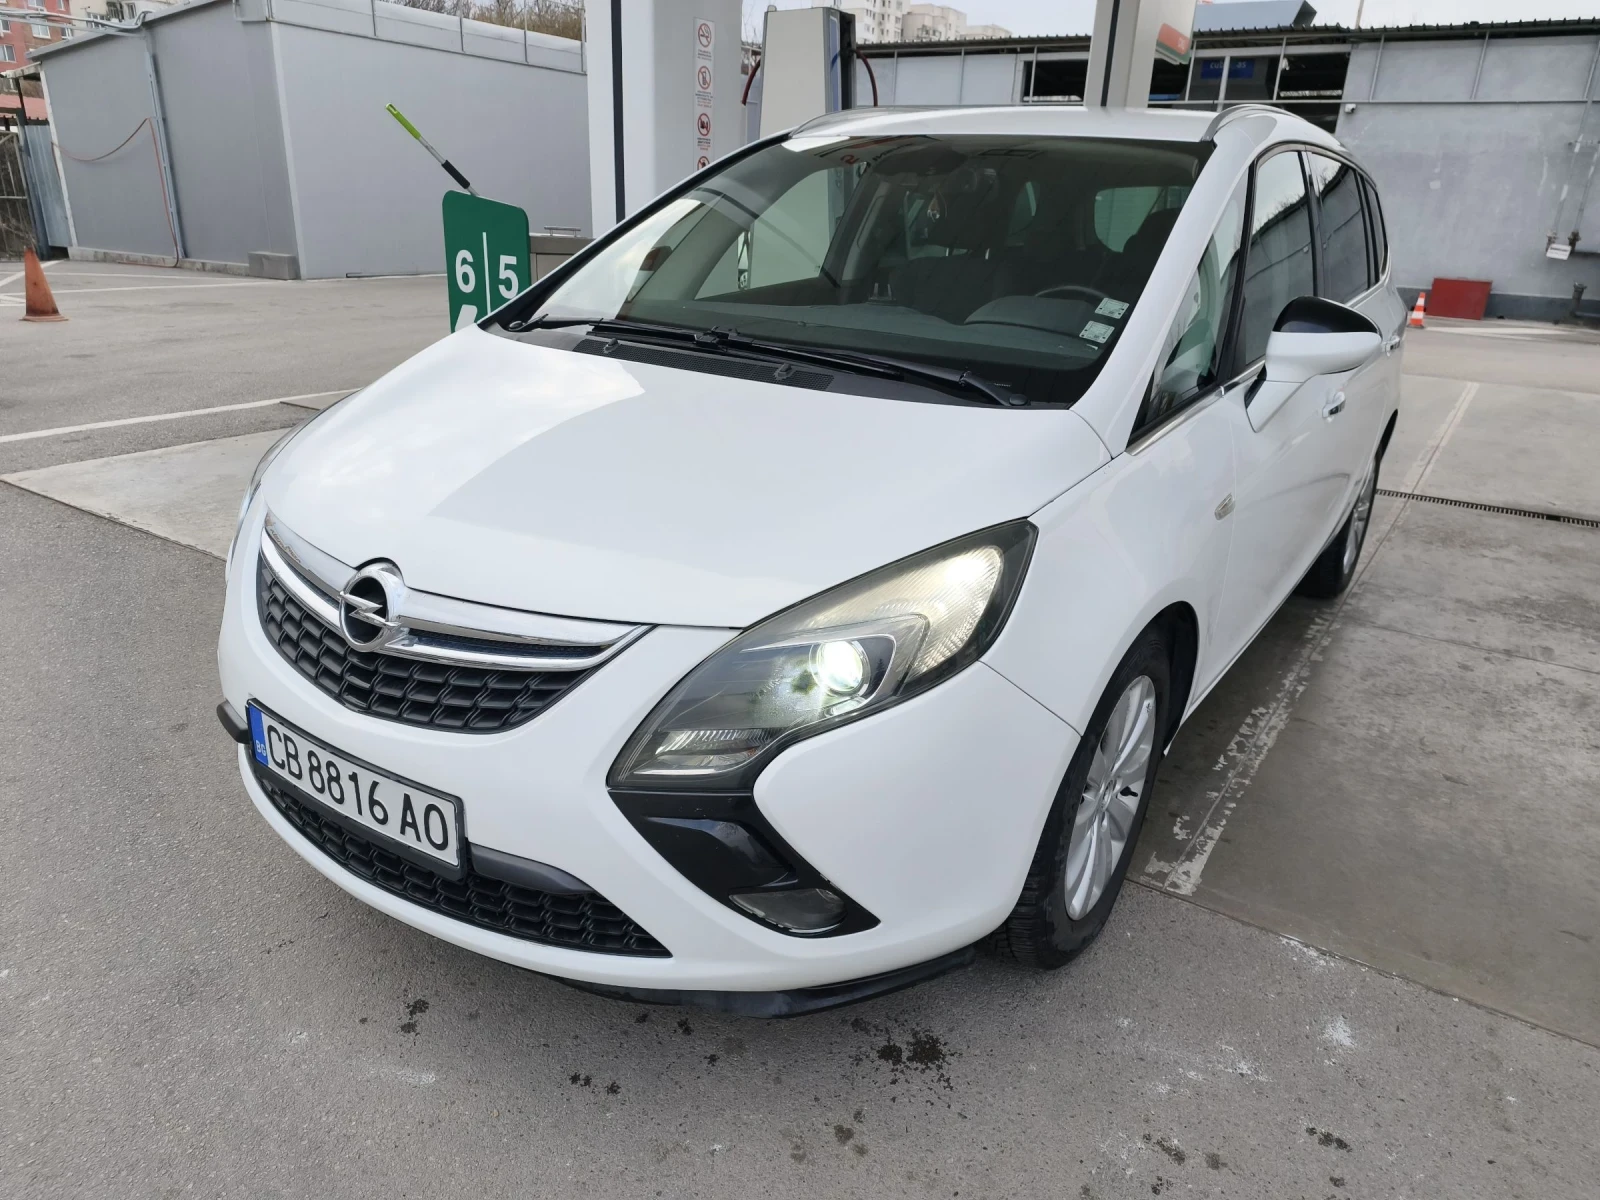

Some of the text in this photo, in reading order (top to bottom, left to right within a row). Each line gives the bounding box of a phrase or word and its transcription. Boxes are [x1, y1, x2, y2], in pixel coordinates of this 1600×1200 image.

[455, 249, 519, 299] 6 5
[255, 740, 266, 756] BG
[267, 725, 448, 851] CB 8816 AO
